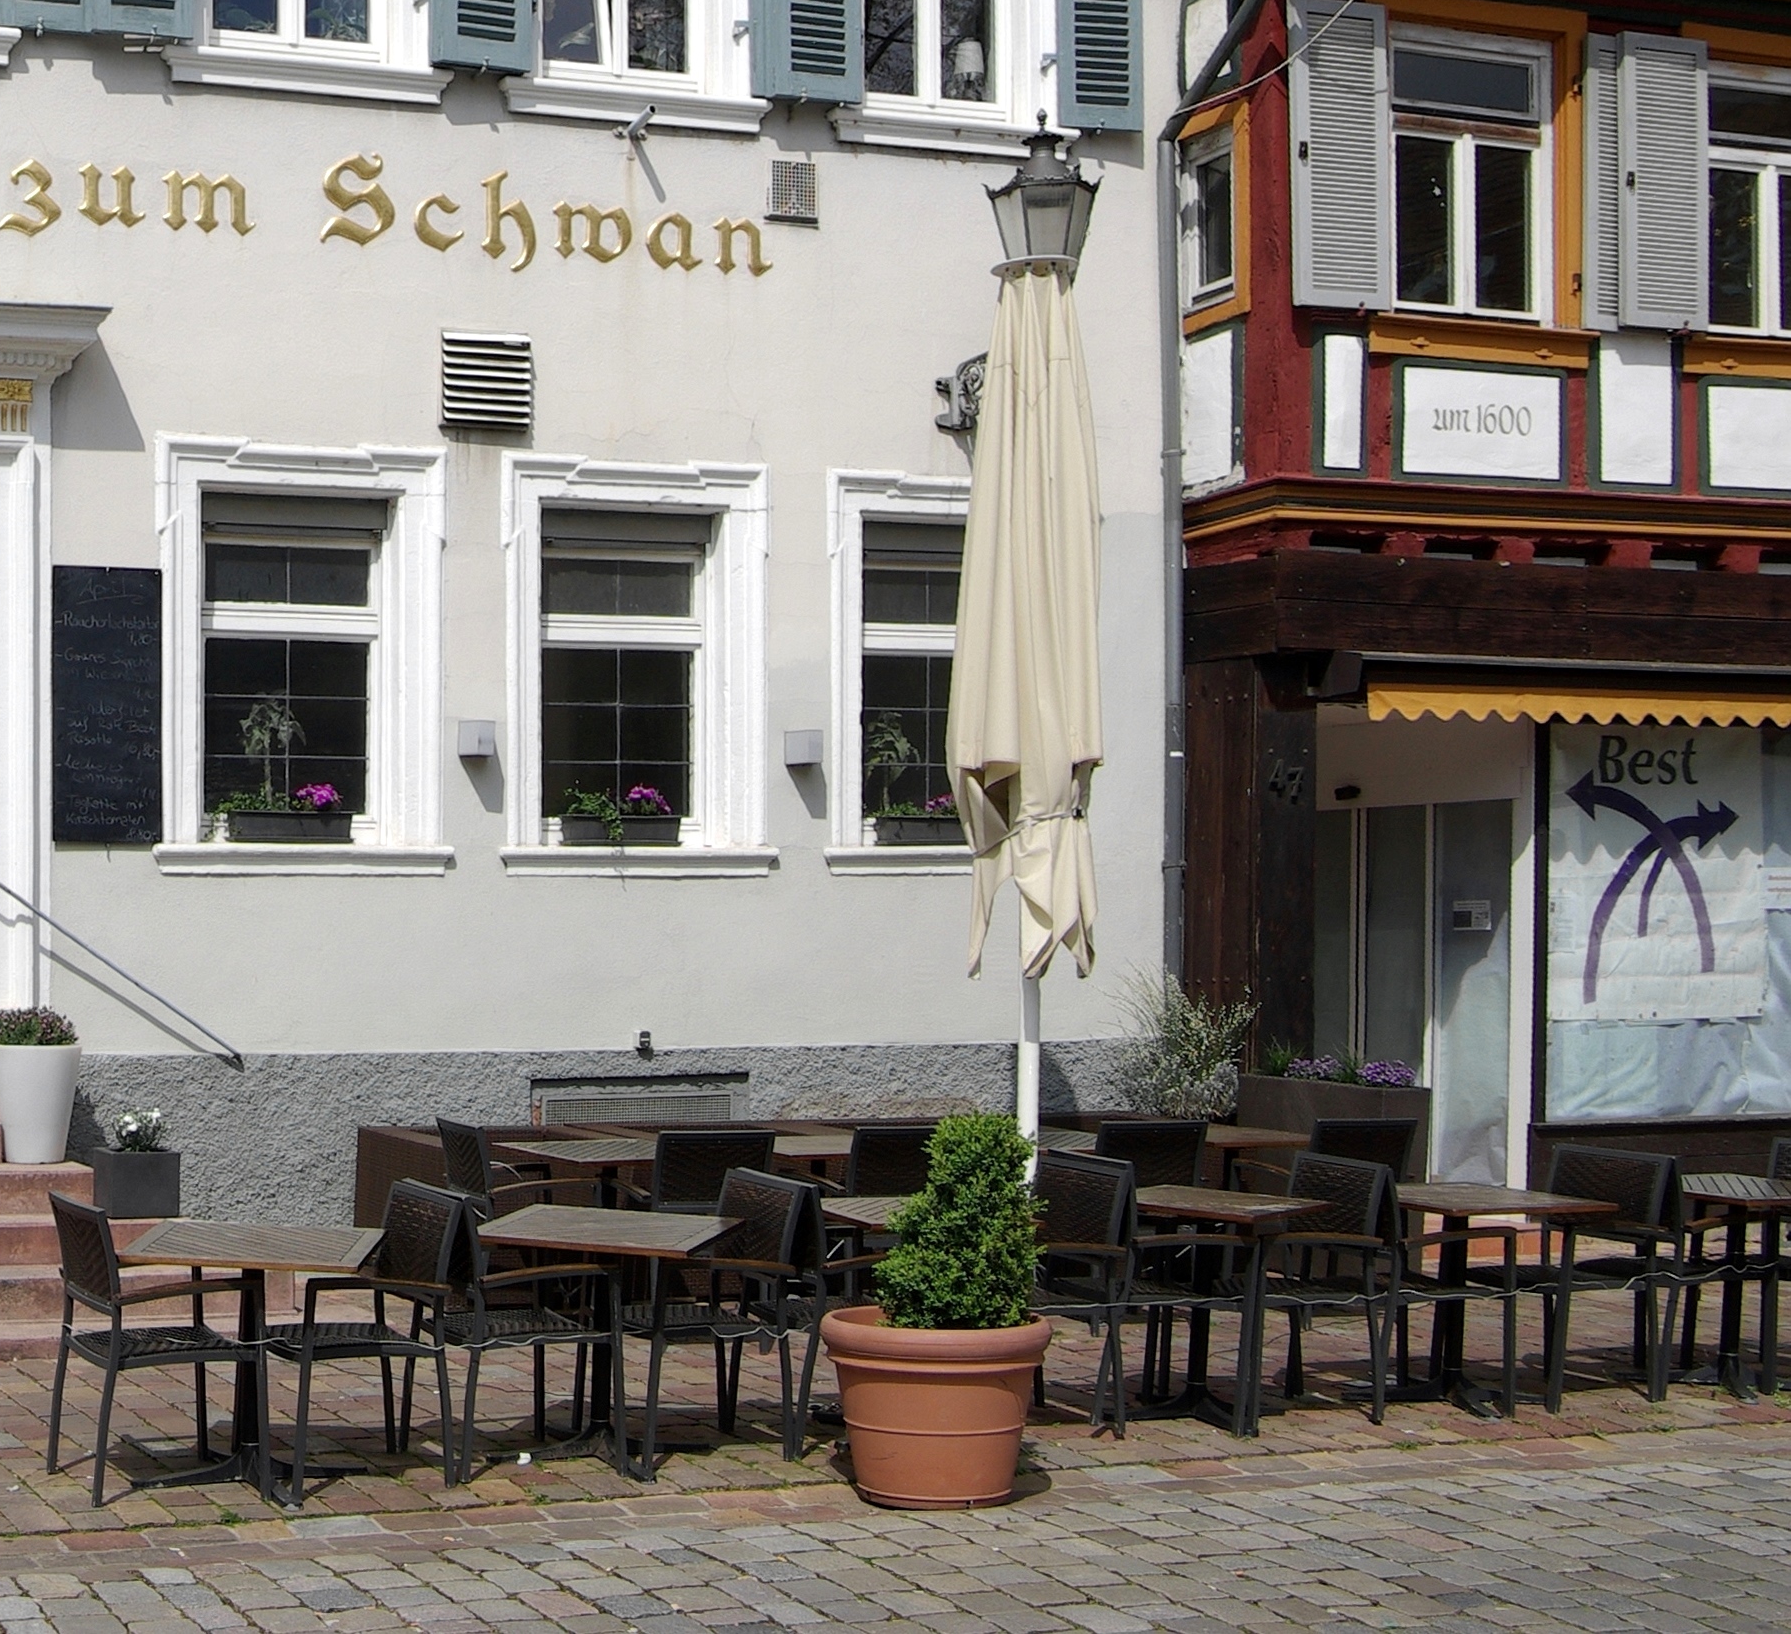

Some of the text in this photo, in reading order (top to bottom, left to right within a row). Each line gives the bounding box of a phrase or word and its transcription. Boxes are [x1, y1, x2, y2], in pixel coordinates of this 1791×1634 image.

[319, 151, 773, 277] Schwan
[1431, 403, 1532, 437] um 1600
[1268, 758, 1305, 797] 47
[1598, 734, 1699, 785] Best
